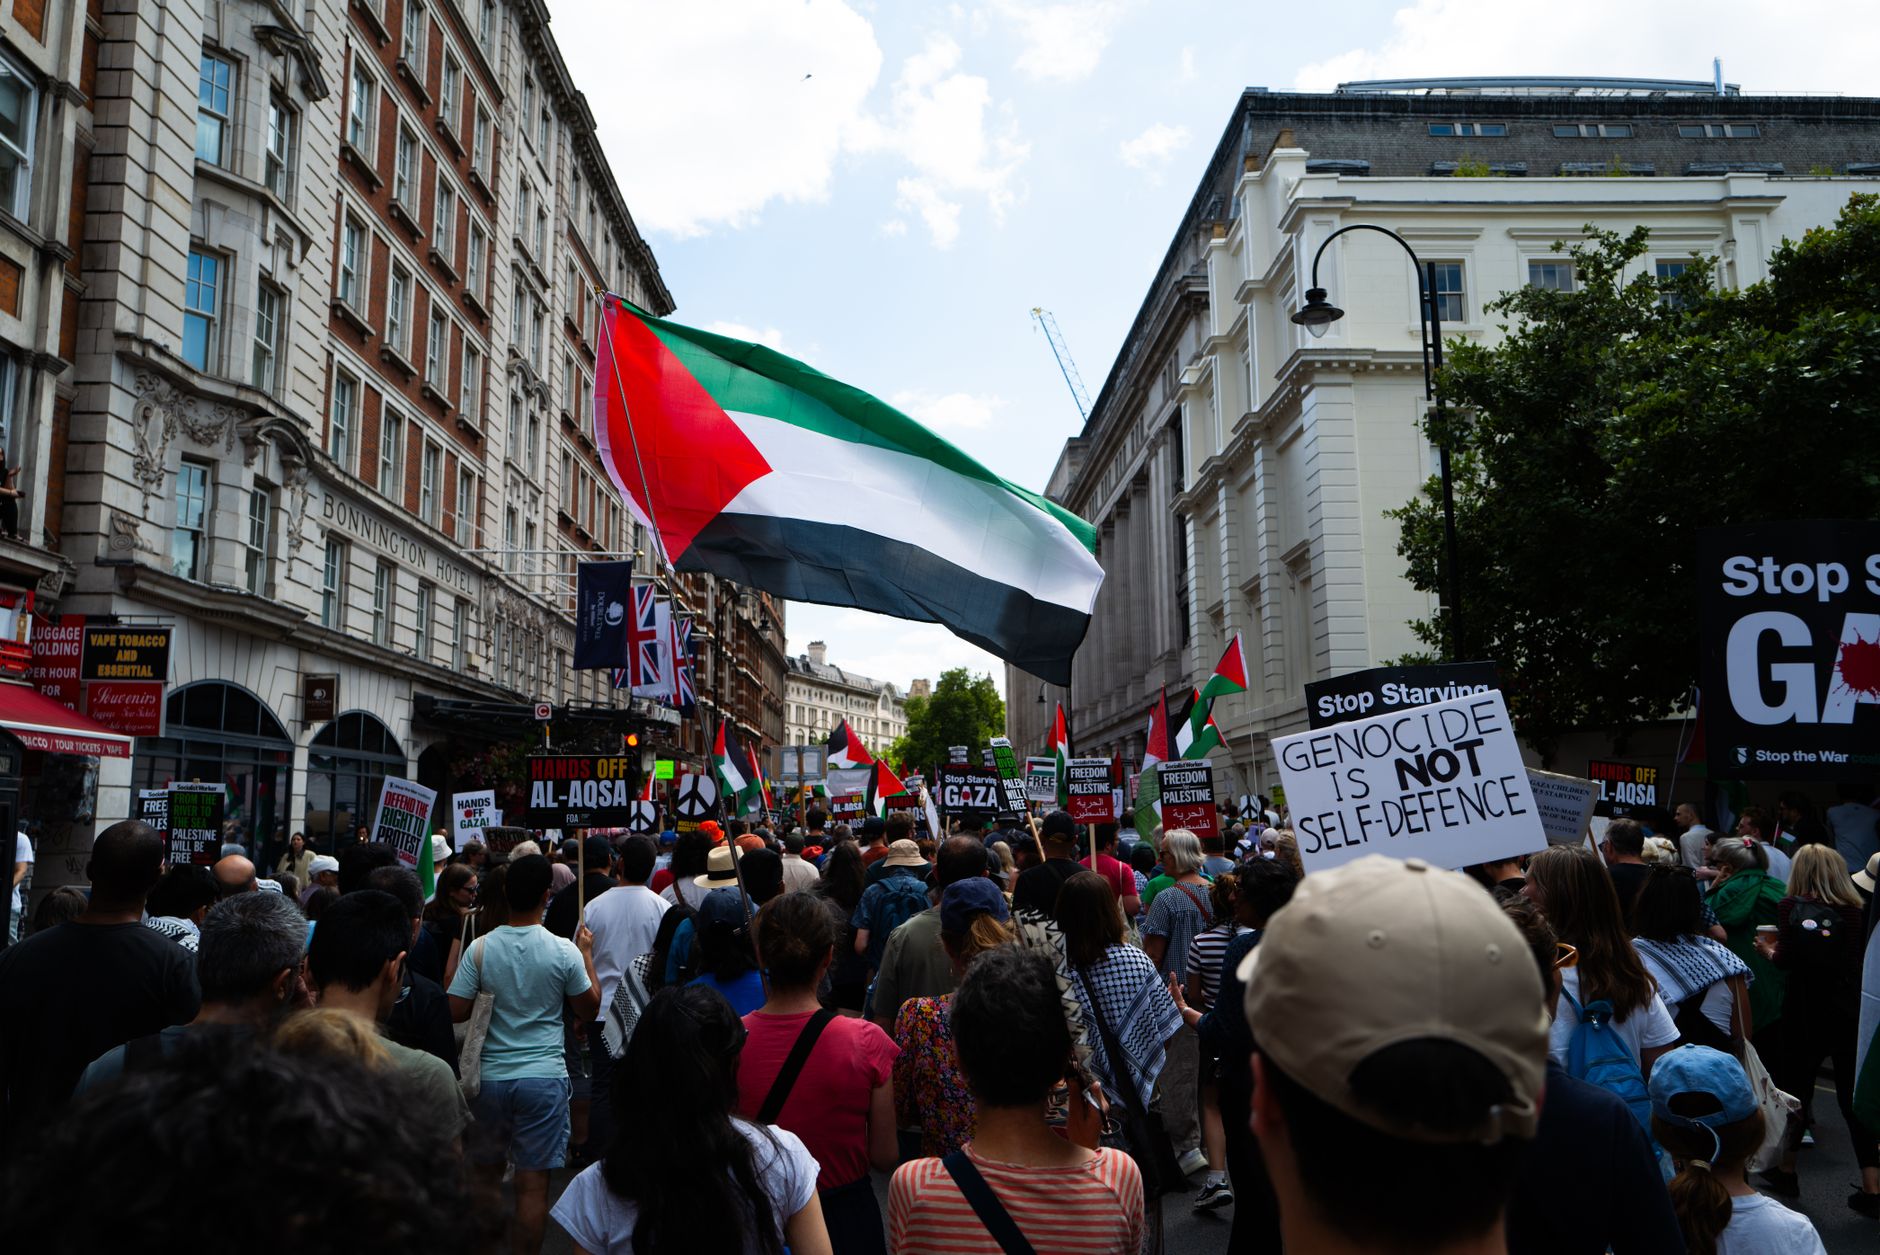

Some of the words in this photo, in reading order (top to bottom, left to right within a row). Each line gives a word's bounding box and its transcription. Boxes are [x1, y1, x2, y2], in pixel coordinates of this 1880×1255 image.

[323, 493, 427, 569] BONNINGTON
[436, 557, 473, 595] HOTEL
[1721, 555, 1850, 603] Stop
[31, 626, 80, 640] LUGGAGE
[90, 634, 117, 647] VAPE
[119, 634, 166, 648] TOBACCO
[116, 649, 138, 662] AND
[49, 667, 77, 679] HOUR
[97, 664, 154, 678] ESSENTIAL
[41, 684, 61, 697] FOR
[93, 686, 156, 705] Souvenirs
[1318, 690, 1374, 718] Stop
[1283, 700, 1501, 772] GENOCIDE
[55, 739, 74, 751] TOUR
[75, 741, 101, 753] TICKETS
[106, 744, 123, 755] VAPE
[1755, 749, 1790, 764] Stop
[1792, 750, 1817, 762] the
[1818, 750, 1849, 763] War
[530, 757, 591, 779] HANDS
[597, 757, 628, 779] OFF
[1070, 767, 1108, 778] FREEDOM
[1332, 768, 1370, 802] IS
[1395, 738, 1484, 791] NOT
[1591, 761, 1633, 780] HANDS
[1635, 767, 1657, 784] OFF
[945, 774, 965, 785] Stop
[1027, 776, 1055, 787] FREE
[1163, 770, 1208, 785] FREEDOM
[530, 779, 628, 810] AL-AQSA
[1069, 782, 1110, 794] PALESTINE
[174, 793, 198, 804] FROM
[200, 793, 217, 805] THE
[945, 784, 998, 807] GAZA
[1162, 788, 1212, 804] PALESTINE
[173, 805, 198, 816] RIVER
[201, 806, 212, 816] TO
[384, 790, 417, 813] DEFEND
[415, 799, 429, 819] THE
[457, 797, 491, 810] HANDS
[566, 813, 579, 824] FOA
[1299, 775, 1526, 854] SELF-DEFENCE
[173, 817, 190, 828] THE
[191, 818, 207, 828] SEA
[380, 806, 414, 833] RIGHT
[412, 816, 426, 838] TO
[460, 818, 490, 829] GAZA!
[172, 828, 217, 840] PALESTINE
[376, 825, 421, 857] PROTEST
[171, 840, 192, 851] WILL
[193, 840, 205, 852] BE
[170, 851, 192, 864] FREE
